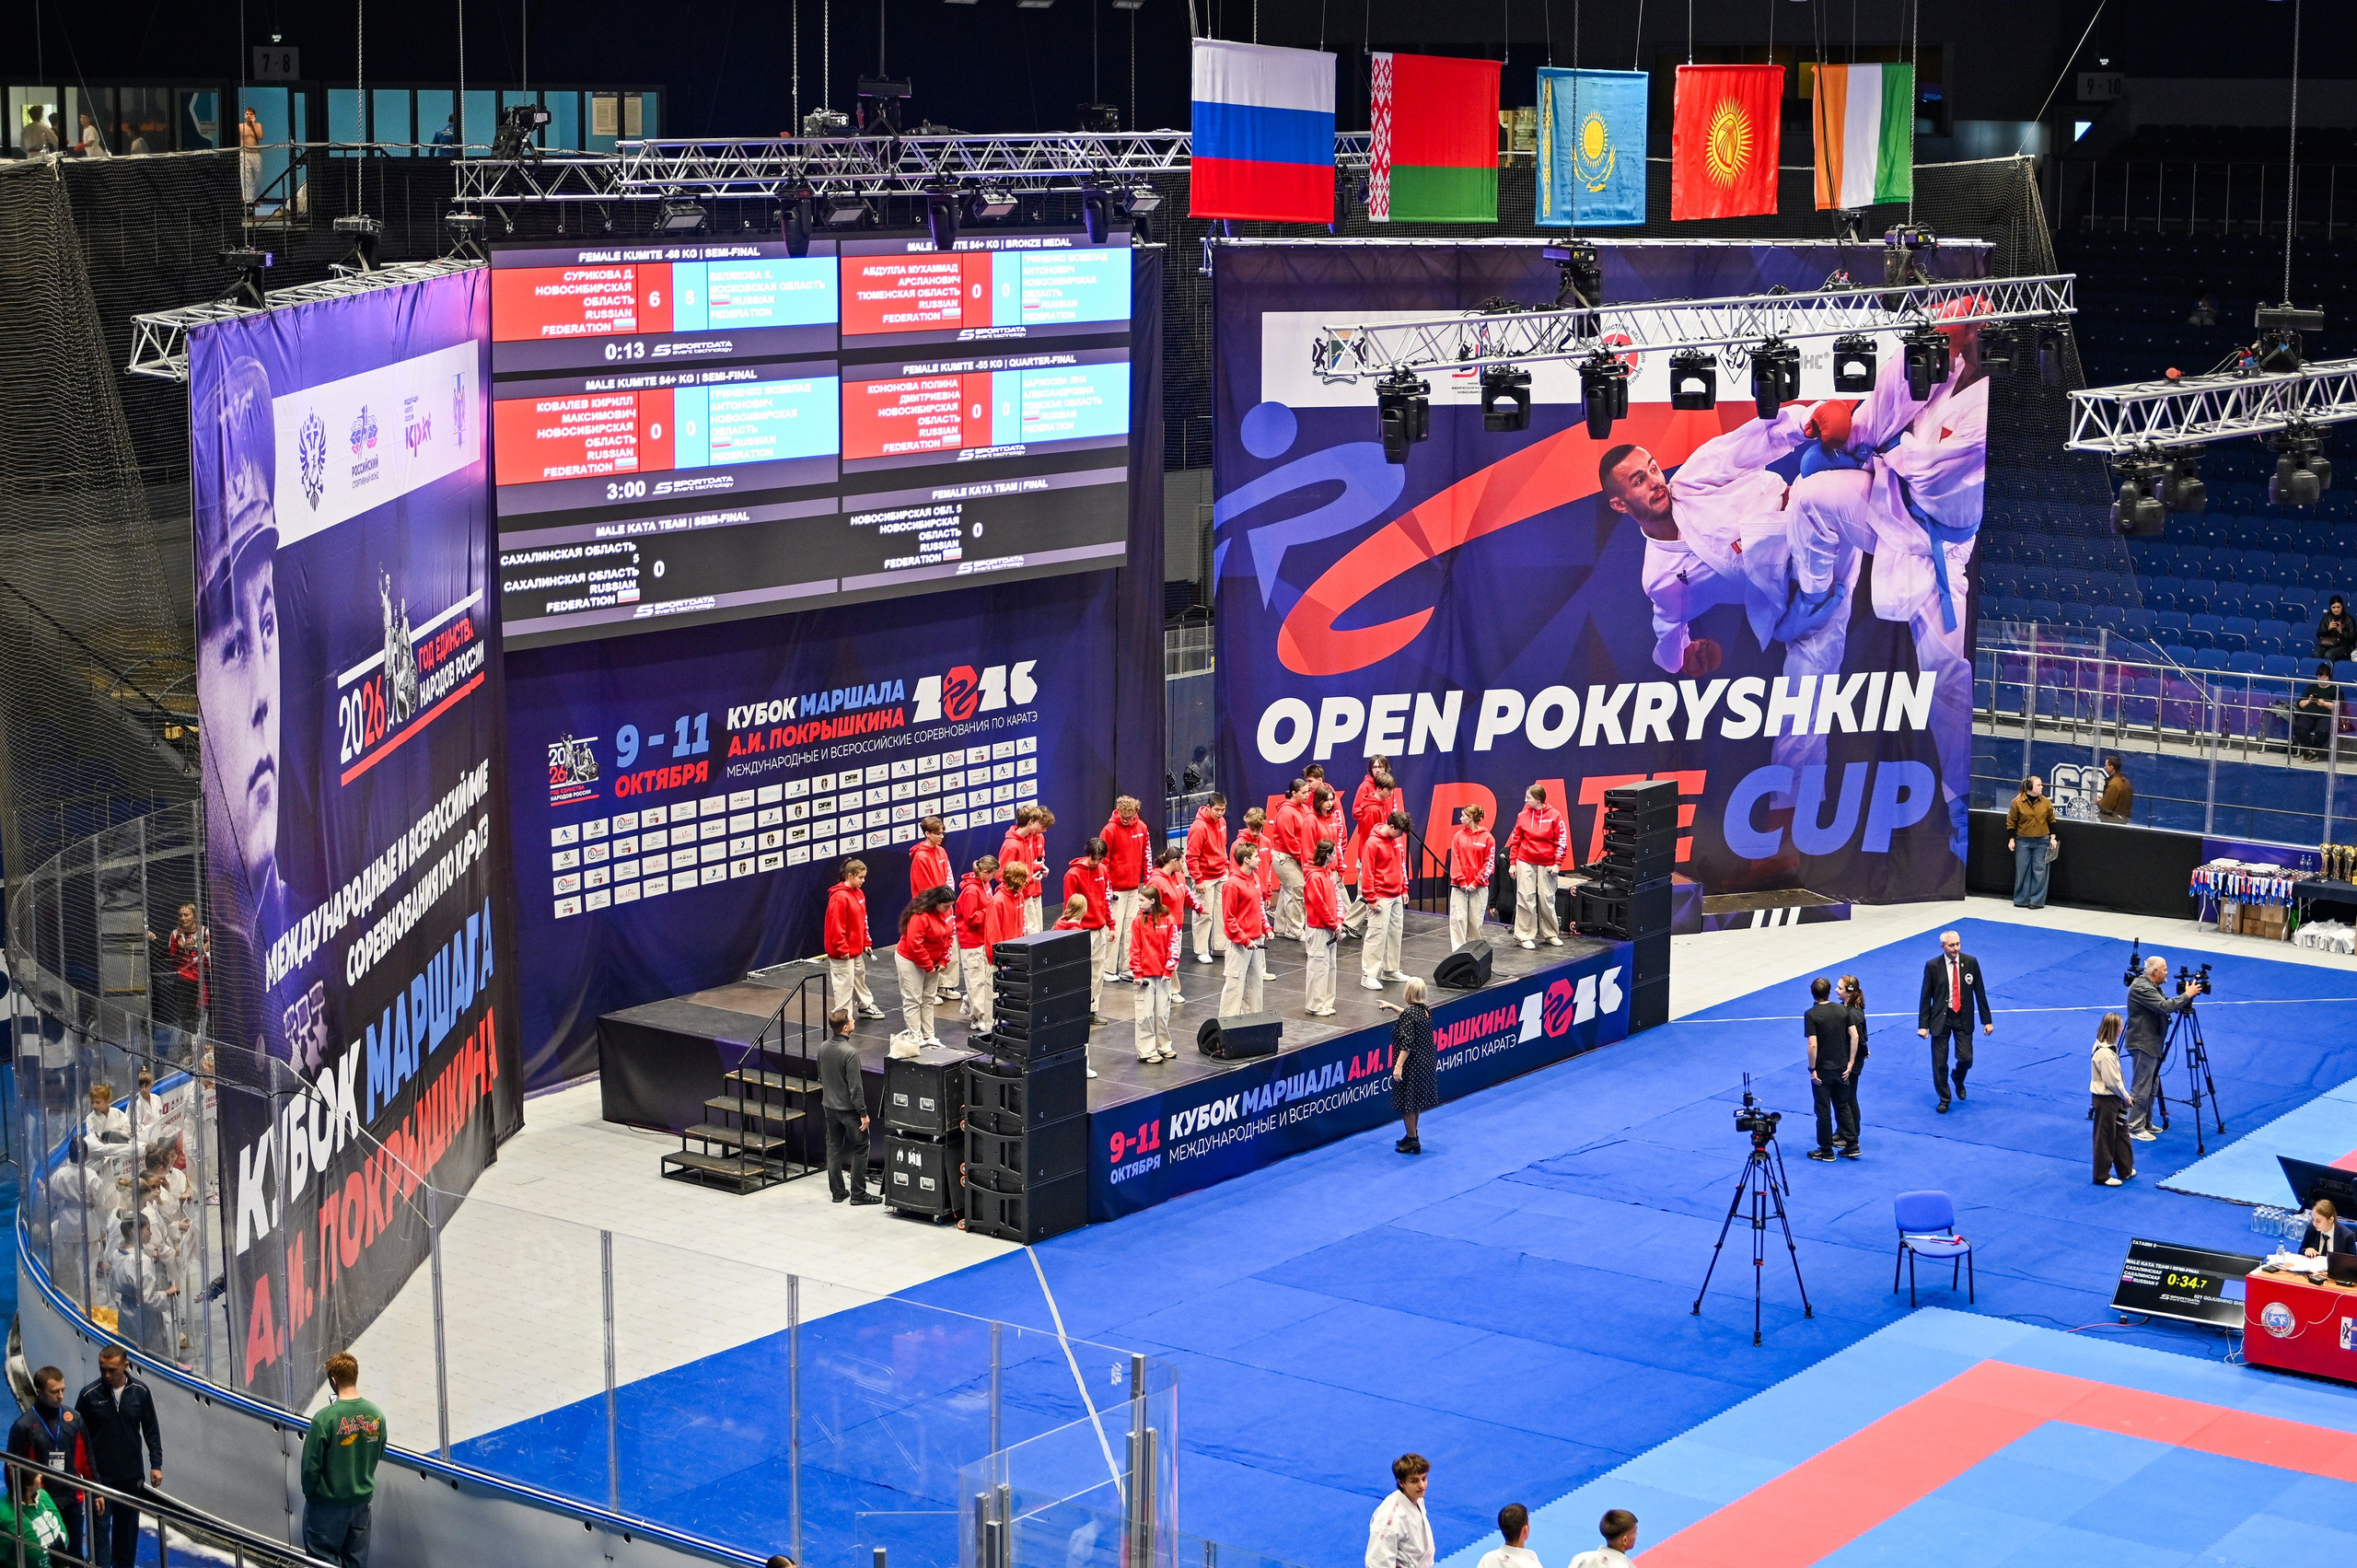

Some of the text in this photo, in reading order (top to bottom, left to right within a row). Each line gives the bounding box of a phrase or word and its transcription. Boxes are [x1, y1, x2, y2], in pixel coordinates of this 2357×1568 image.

[283, 53, 290, 73] 8
[907, 242, 935, 251] MALE
[986, 240, 999, 249] KG
[1005, 238, 1040, 248] BRONZE
[1042, 238, 1071, 247] MEDAL
[579, 251, 621, 261] FEMALE
[624, 250, 663, 261] KUMITE
[683, 249, 697, 259] KG
[705, 247, 760, 258] SEMI-FINAL
[563, 269, 633, 281] СУРИКОВА Д.
[864, 263, 958, 276] АБДУЛЛА МУХАММАД
[899, 275, 959, 285] АРСЛАНОВИЧ
[535, 282, 631, 296] НОВОСИБИРСКАЯ
[857, 287, 959, 300] ТЮМЕНСКАЯ ОБЛАСТЬ
[972, 284, 981, 297] 0
[583, 295, 634, 307] ОБЛАСТЬ
[648, 291, 660, 307] 6
[919, 299, 958, 308] RUSSIAN
[585, 308, 632, 319] RUSSIAN
[883, 312, 939, 322] FEDERATION
[542, 322, 610, 335] FEDERATION
[605, 340, 732, 360] 0:13 SPORTDATA
[903, 364, 938, 374] FEMALE
[940, 361, 973, 371] KUMITE
[990, 359, 1002, 368] KG
[1009, 354, 1075, 367] QUARTER-FINAL
[586, 378, 615, 390] MALE
[617, 376, 656, 389] KUMITE
[679, 374, 694, 384] KG
[702, 369, 757, 382] SEMI-FINAL
[868, 378, 958, 393] КОНОНОВА ПОЛИНА
[537, 396, 633, 412] КОВАЛЕВ КИРИЛЛ
[900, 390, 959, 403] ДМИТРИЕВНА
[562, 408, 635, 423] МАКСИМОВИЧ
[878, 402, 958, 417] НОВОСИБИРСКАЯ
[971, 404, 981, 418] 0
[917, 414, 959, 425] ОБЛАСТЬ
[537, 422, 633, 438] НОВОСИБИРСКАЯ
[651, 424, 661, 439] 0
[585, 435, 636, 447] ОБЛАСТЬ
[586, 447, 633, 460] RUSSIAN
[543, 461, 612, 477] FEDERATION
[607, 475, 733, 500] 3:00 SPORTDATA
[932, 479, 1048, 499] FEMALE KATA TEAM FINAL
[851, 507, 931, 525] НОВОСИБИРСКАЯ
[933, 505, 954, 516] ОБЛ.
[596, 511, 749, 537] MALE KATA TEAM SEMI-FINAL
[879, 517, 958, 533] НОВОСИБИРСКАЯ
[973, 522, 982, 537] 0
[919, 528, 960, 540] ОБЛАСТЬ
[501, 540, 636, 565] САХАЛИНСКАЯ ОБЛАСТЬ
[633, 553, 639, 563] 5
[654, 560, 665, 577] 0
[504, 566, 639, 591] САХАЛИНСКАЯ ОБЛАСТЬ
[589, 579, 635, 594] RUSSIAN
[547, 595, 615, 612] FEDERATION
[418, 617, 474, 673] ГОД ЕДИНСТВА
[420, 667, 455, 708] НАРОДОВ
[726, 679, 905, 730] КУБОК МАРШАЛА
[339, 674, 385, 764] 2026
[1256, 670, 1938, 763] OPEN POKRYSHKIN
[616, 713, 710, 768] 9 11
[727, 707, 905, 758] А.И. ПОКРЫШКИНА
[726, 711, 1038, 778] МЕЖДУНАРОДНЫЕ И ВСЕРОССИЙСКИЕ СОРЕВНОВАНИЯ ПО КАРАТЭ
[549, 747, 565, 767] 20
[549, 765, 566, 784] 26
[615, 760, 709, 798] ОКТЯБРЯ
[550, 793, 572, 802] НАРОДОВ
[1723, 760, 1937, 859] CUP
[266, 846, 397, 993] МЕЖДУНАРОДНЫЕ
[346, 872, 439, 986] СОРЕВНОВАНИЯ
[439, 855, 454, 898] ПО
[1169, 1095, 1240, 1140] КУБОК
[1242, 1061, 1345, 1116] МАРШАЛА
[1347, 1048, 1384, 1082] А.И.
[1169, 1033, 1517, 1164] МЕЖДУНАРОДНЫЕ И ВСЕРОССИЙСКИЕ ПО КАРАТЭ
[236, 1038, 361, 1257] КУБОК
[1110, 1119, 1160, 1163] 9-11
[1110, 1154, 1162, 1185] ОКТЯБРЯ
[245, 1005, 498, 1388] А.И. ПОКРЫШКИНА
[2167, 1273, 2208, 1289] 0:34.7
